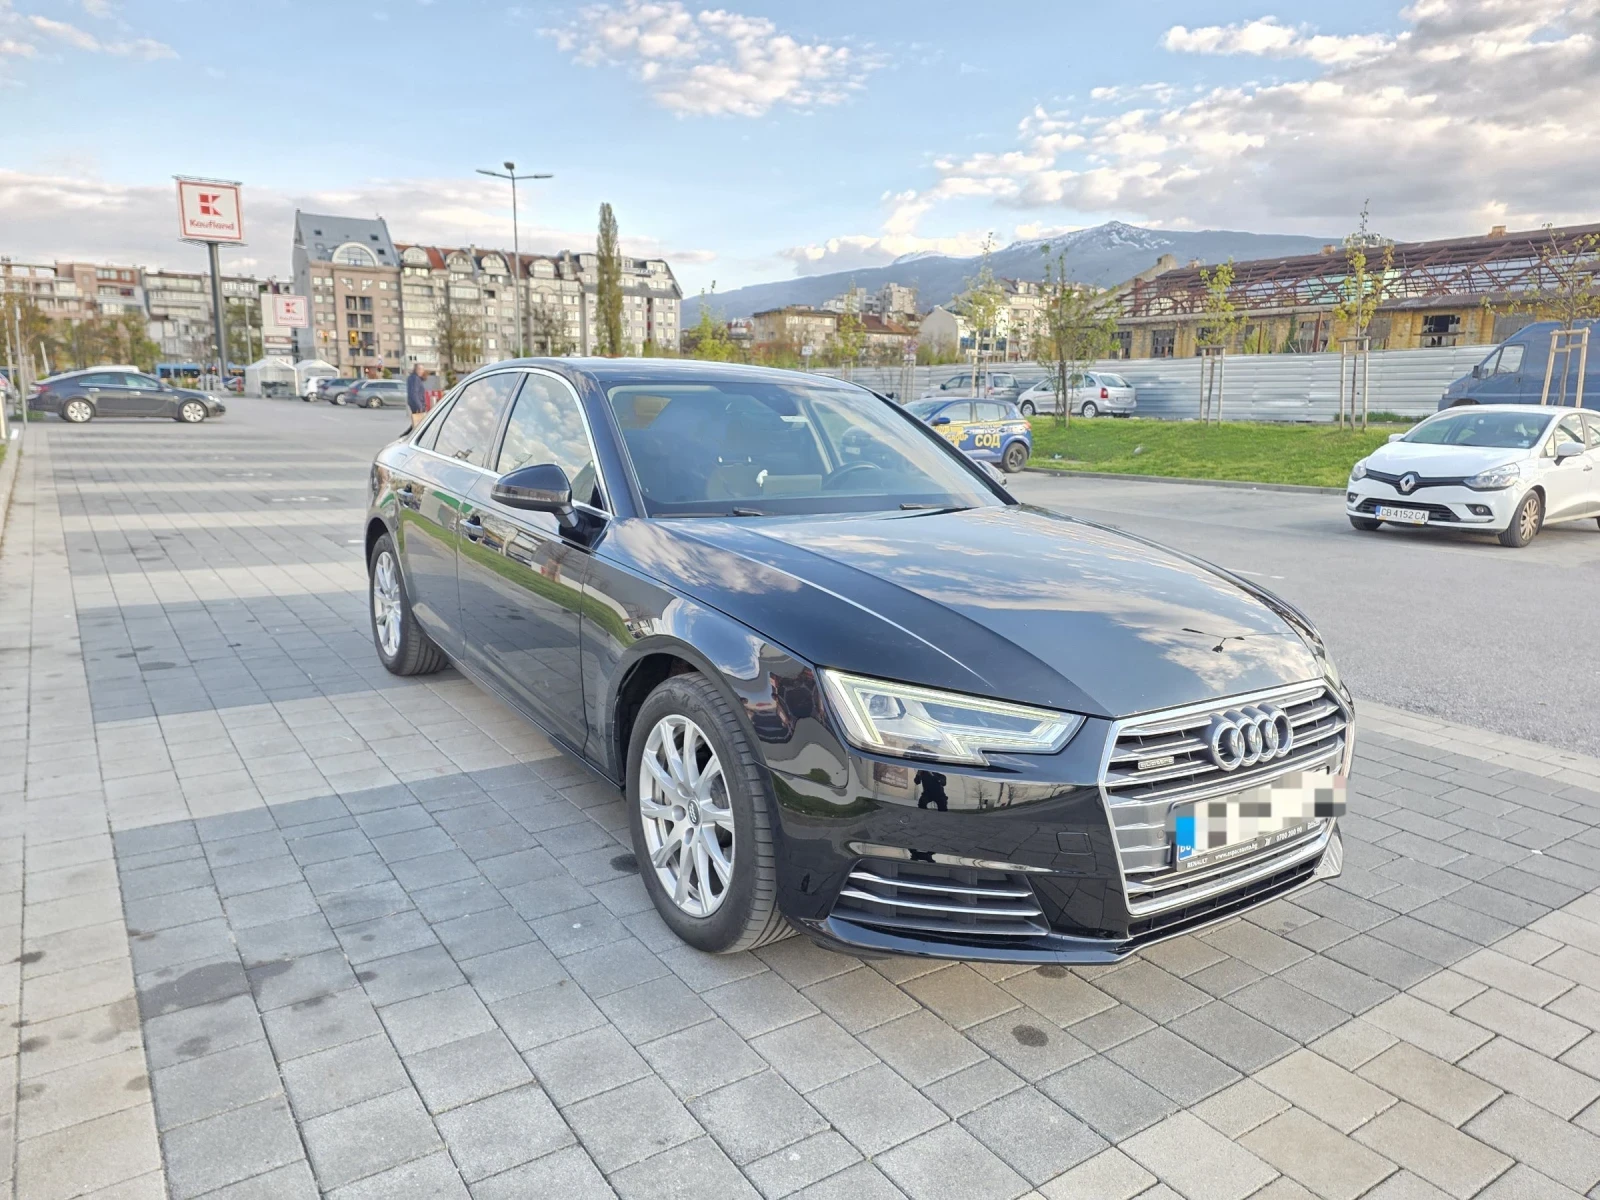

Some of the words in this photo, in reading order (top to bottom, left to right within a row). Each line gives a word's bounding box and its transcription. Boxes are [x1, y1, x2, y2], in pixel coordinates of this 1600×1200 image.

[189, 219, 234, 230] Kaufland
[974, 433, 1000, 448] СОД
[1381, 508, 1392, 517] CB
[1393, 510, 1414, 519] 4152
[1414, 511, 1426, 520] CA
